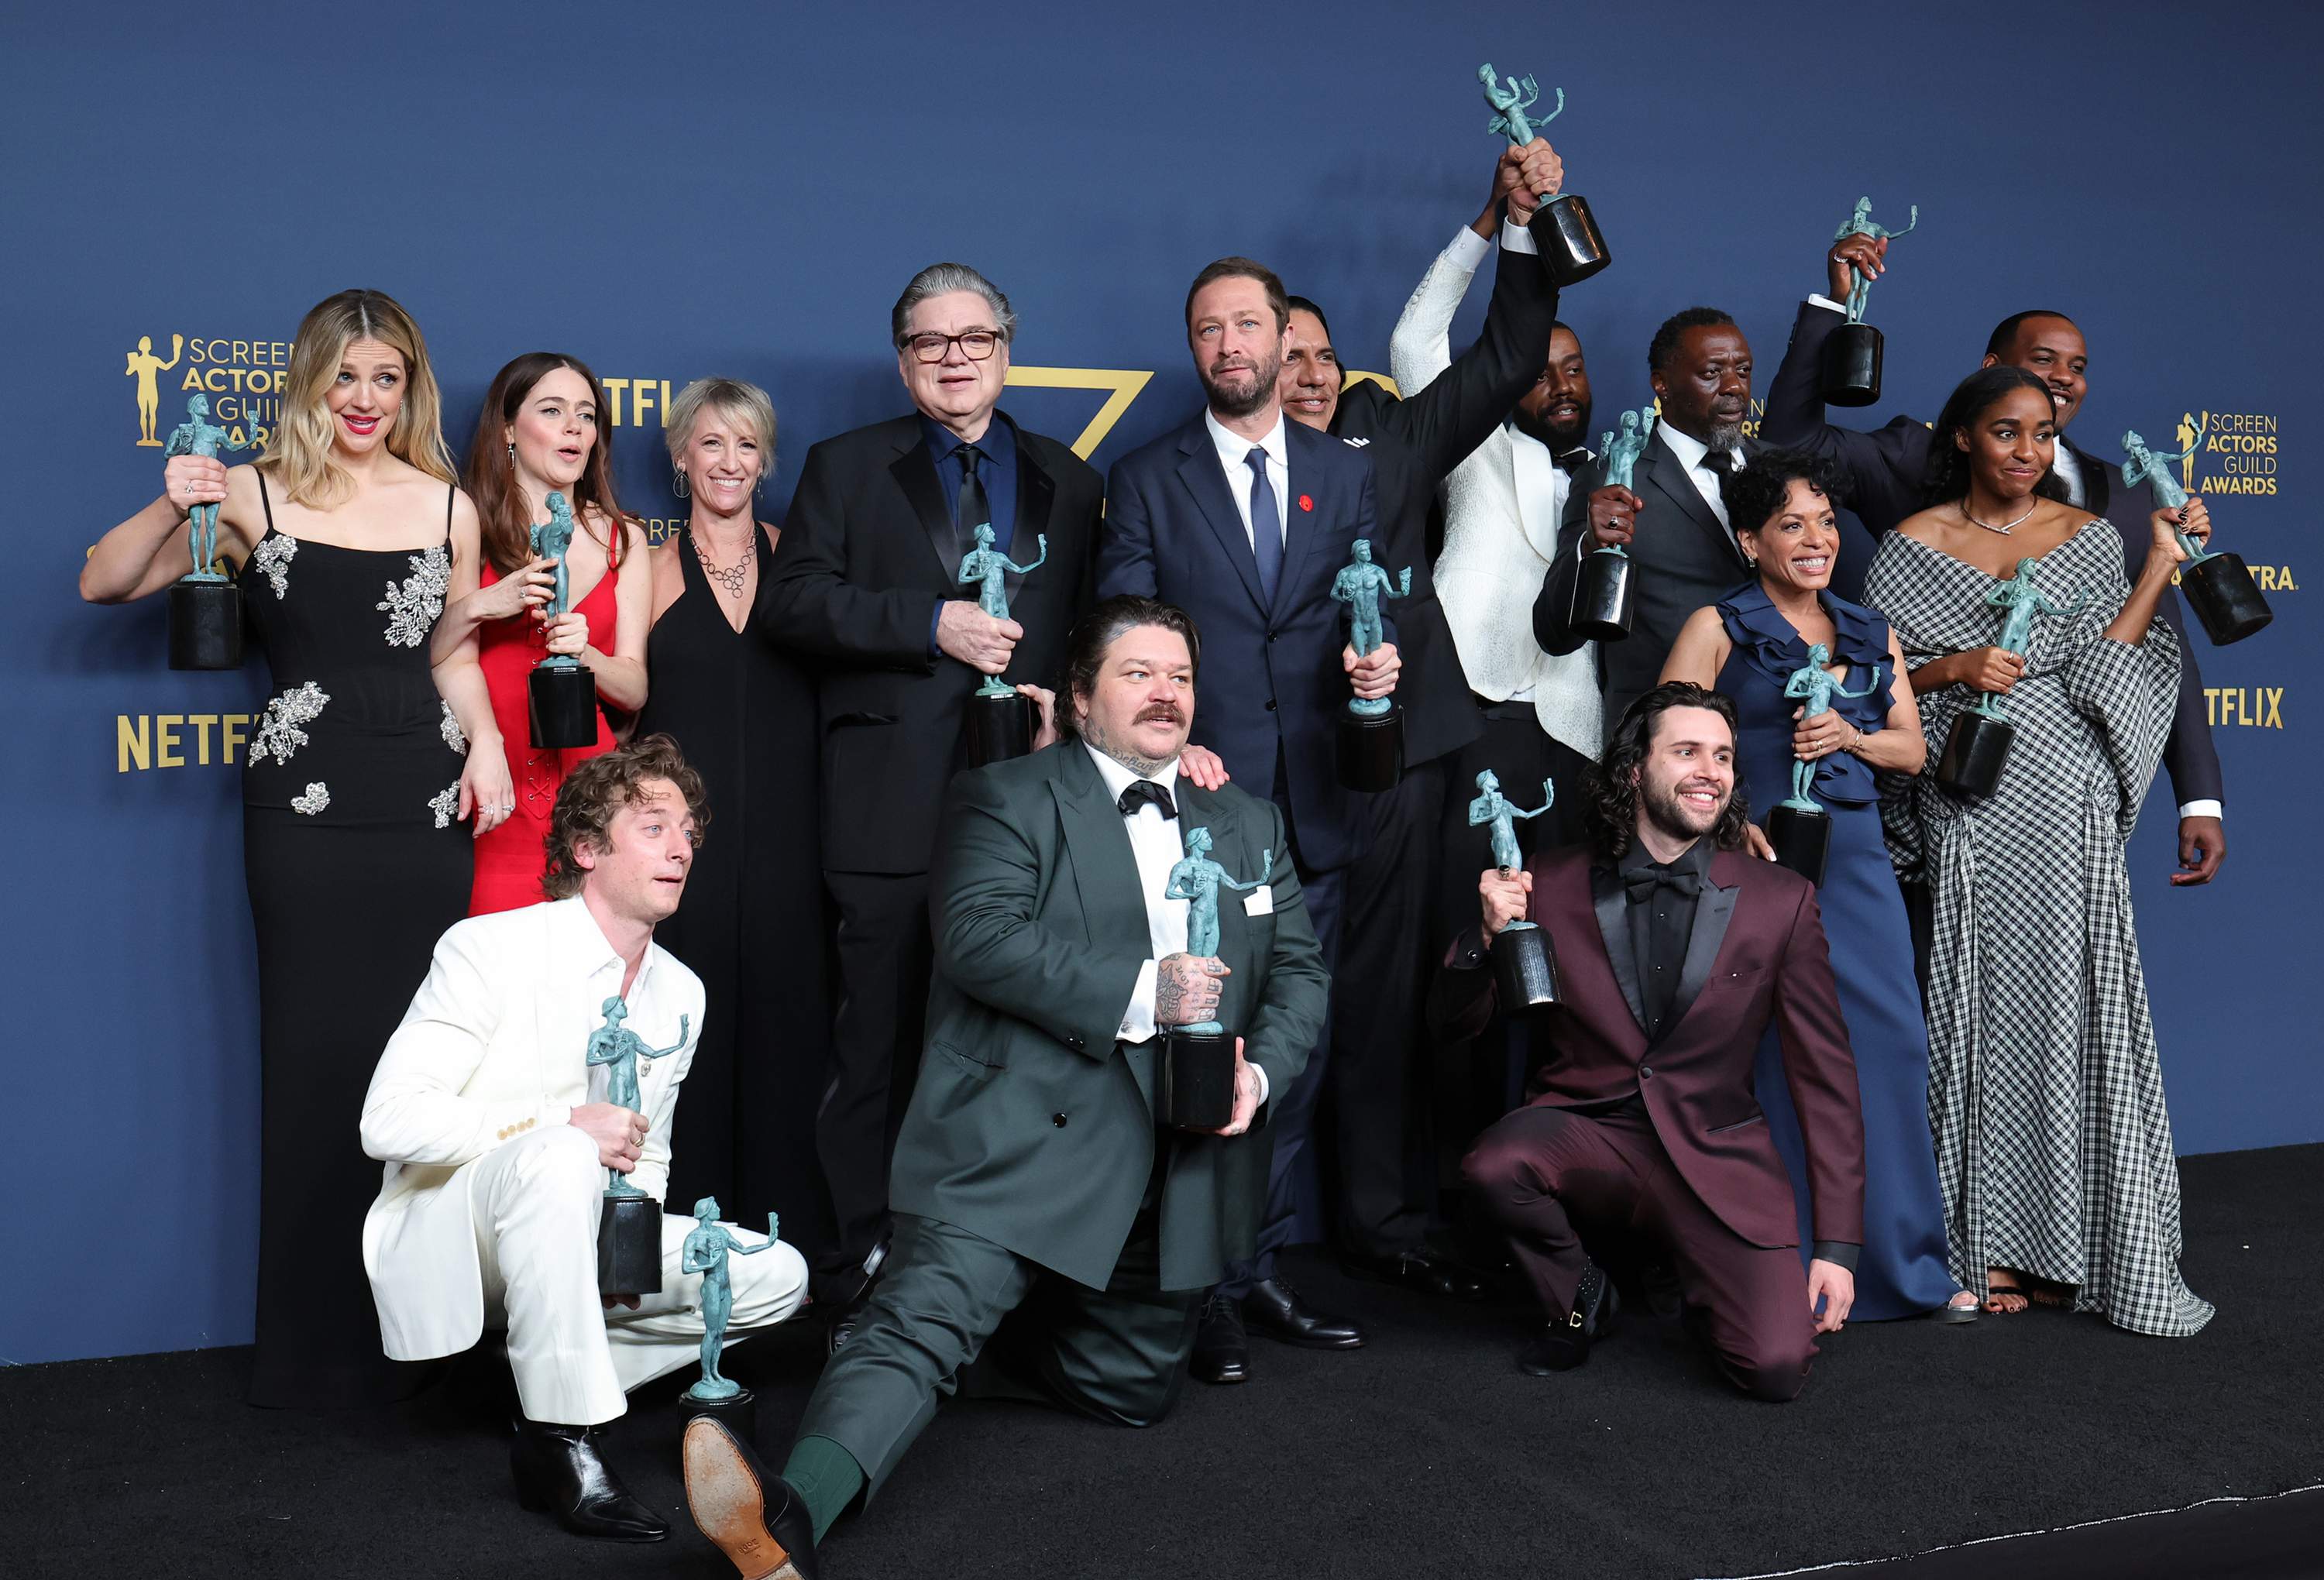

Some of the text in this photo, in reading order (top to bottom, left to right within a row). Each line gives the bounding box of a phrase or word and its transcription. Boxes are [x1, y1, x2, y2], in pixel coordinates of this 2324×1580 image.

[2211, 414, 2277, 433] SCREEN
[2205, 434, 2278, 454] ACTORS
[2224, 455, 2277, 474] GUILD
[2201, 476, 2278, 496] AWARDS
[2203, 688, 2284, 729] TFLIX
[117, 714, 260, 773] NETF
[1175, 965, 1190, 986] LOVE
